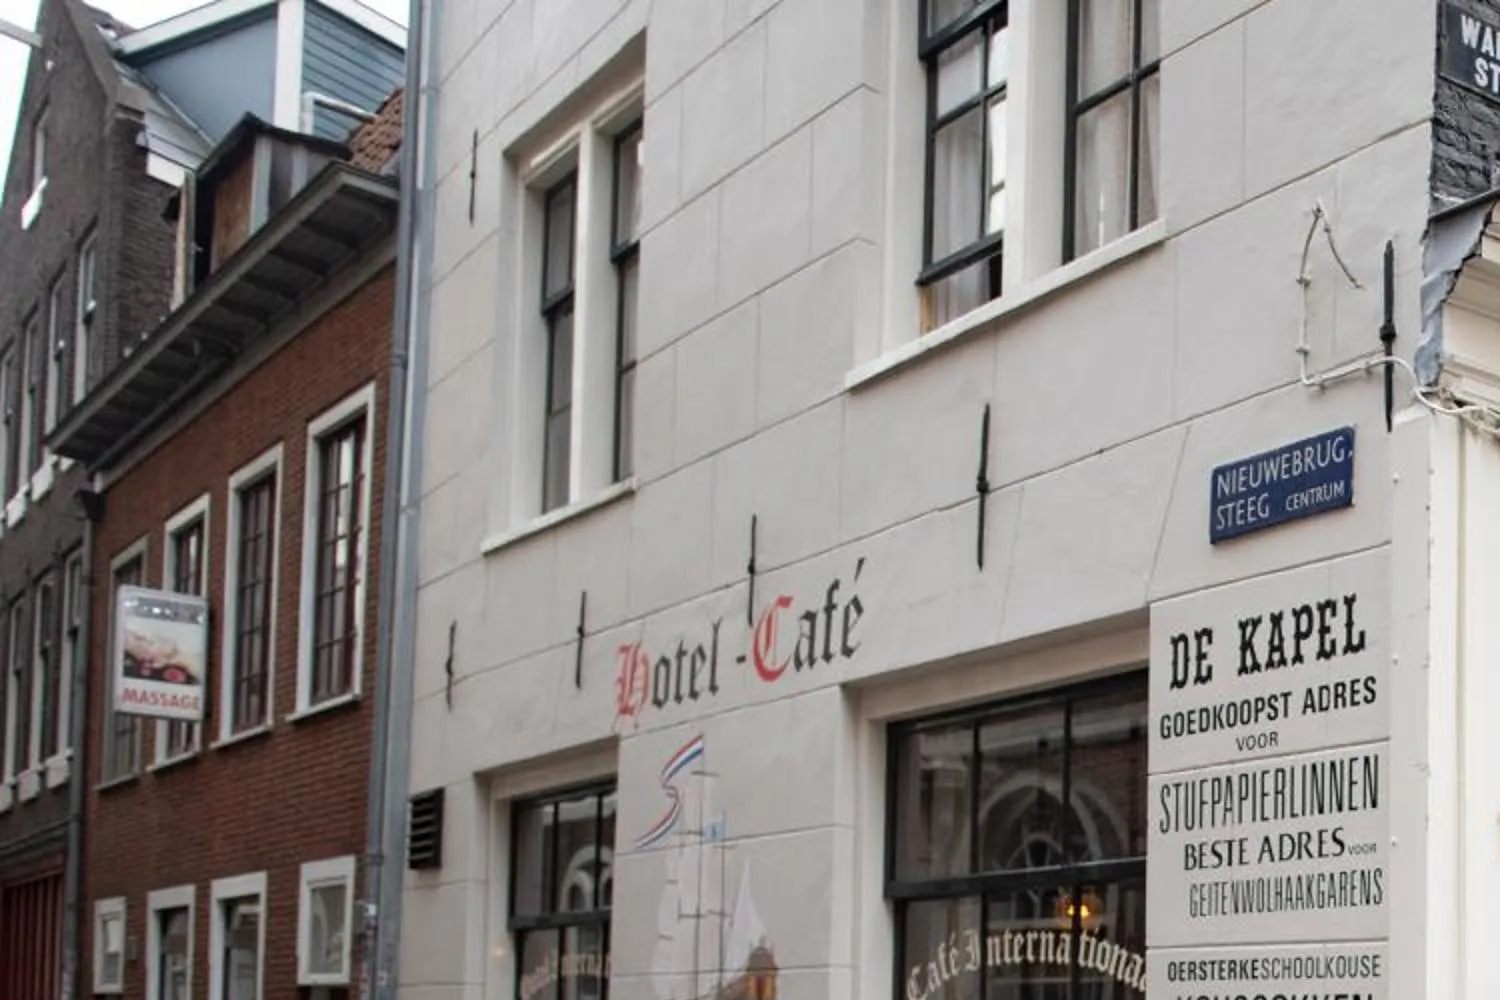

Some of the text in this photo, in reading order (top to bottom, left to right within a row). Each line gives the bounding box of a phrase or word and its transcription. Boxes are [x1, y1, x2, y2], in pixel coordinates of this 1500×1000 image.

[1215, 479, 1345, 531] STEEG CENTRUM
[1170, 593, 1365, 690] DE KAPEL
[613, 616, 723, 725] Hotel
[123, 687, 200, 710] MASSAGE
[1160, 675, 1377, 740] GOEDKOOPST ADRES
[1235, 731, 1279, 752] VOOR
[1159, 753, 1379, 834] STUFPAPIERLINNEN
[1184, 827, 1377, 871] BESTE ADRES VOOR
[1189, 867, 1384, 919] GEITENWOLHAAKGARENS
